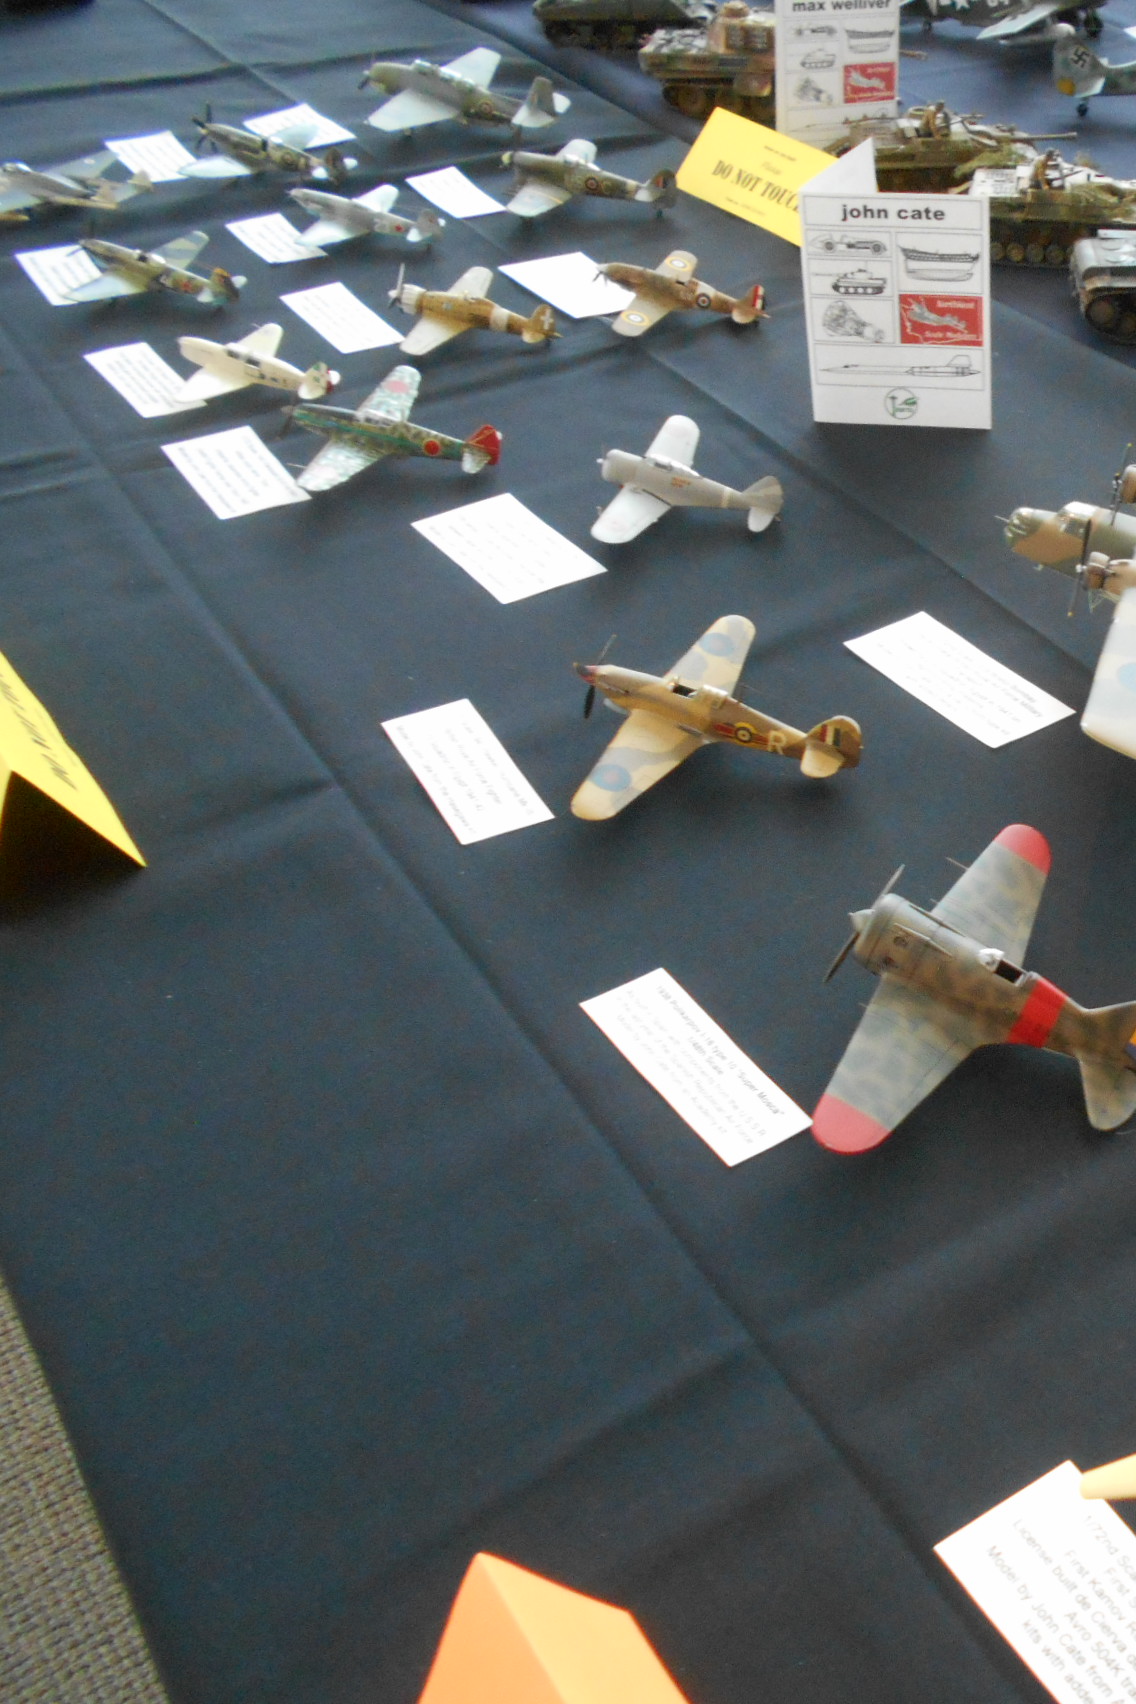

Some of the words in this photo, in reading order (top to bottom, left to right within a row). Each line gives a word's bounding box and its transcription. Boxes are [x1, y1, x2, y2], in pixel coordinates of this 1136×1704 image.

[792, 1, 826, 12] max
[712, 160, 734, 179] DO
[731, 168, 763, 192] NOT
[760, 181, 799, 212] TOUC
[841, 204, 888, 221] john
[896, 206, 946, 221] cate
[767, 730, 786, 754] R
[984, 1547, 1021, 1583] Model
[1014, 1584, 1035, 1602] by
[1030, 1601, 1062, 1633] John
[1056, 1633, 1090, 1666] Cate
[1012, 1521, 1054, 1564] License
[1051, 1566, 1078, 1592] built
[1073, 1592, 1094, 1611] de
[1089, 1611, 1129, 1652] Cierva
[1062, 1550, 1091, 1578] First
[1086, 1579, 1128, 1621] Kamov
[1102, 1568, 1131, 1596] First
[1019, 1620, 1045, 1643] kits
[1039, 1644, 1068, 1672] with
[1063, 1610, 1094, 1641] Avro
[1090, 1642, 1124, 1676] 504K
